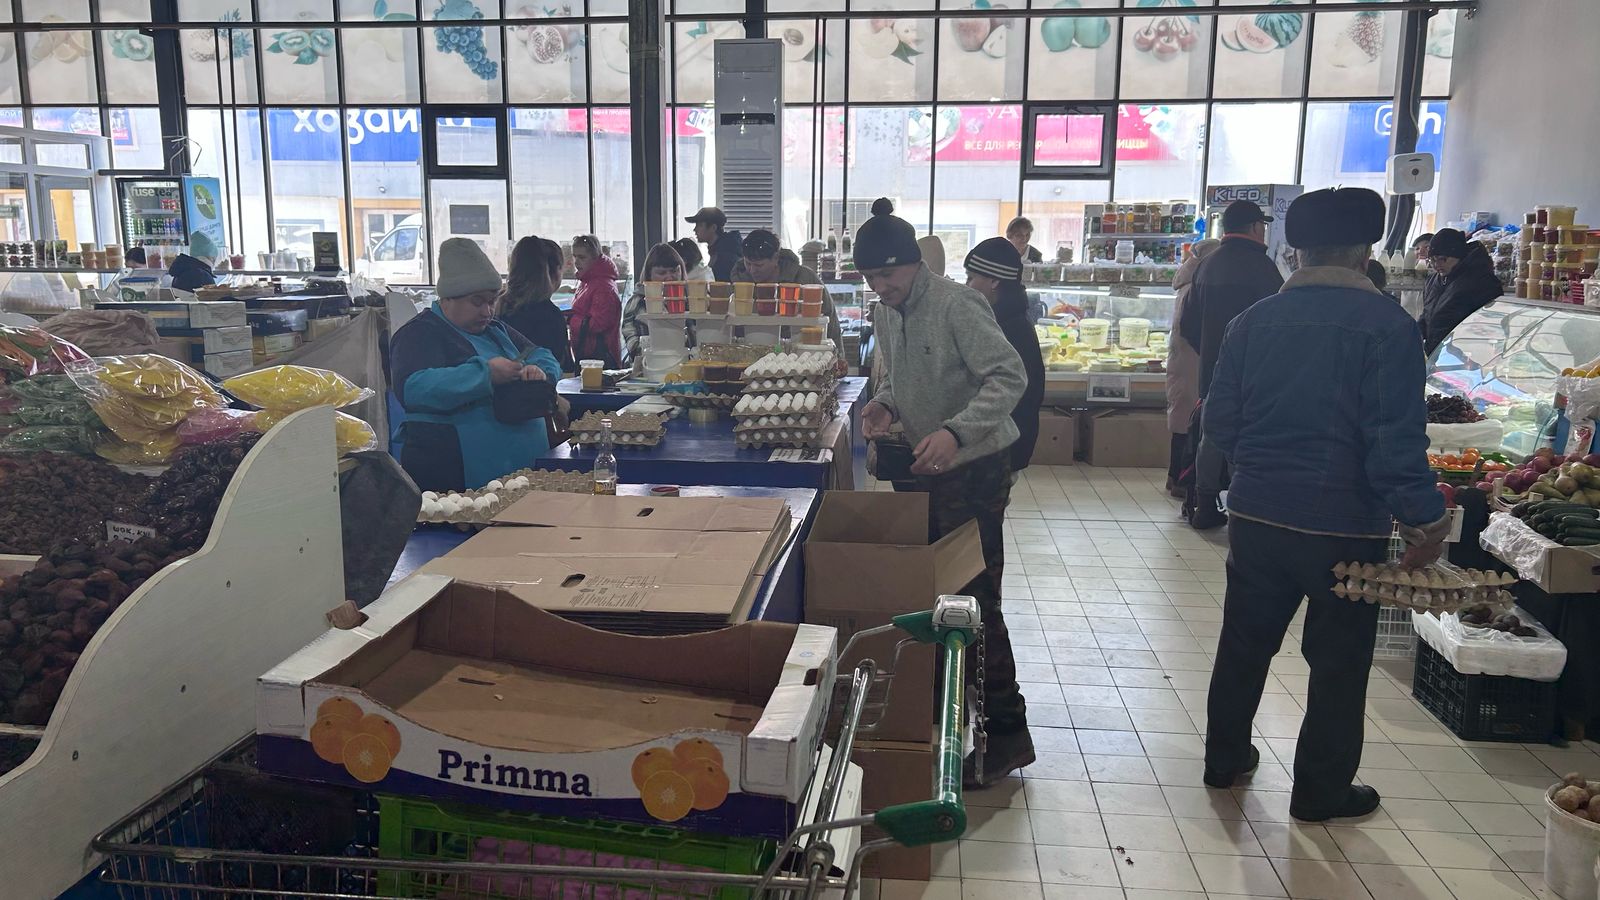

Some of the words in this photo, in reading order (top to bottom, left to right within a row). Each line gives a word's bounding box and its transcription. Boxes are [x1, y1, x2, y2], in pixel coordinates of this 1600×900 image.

[1116, 139, 1148, 150] ИЦЦЫ
[1214, 187, 1260, 201] KLEO
[437, 749, 592, 797] Primma
